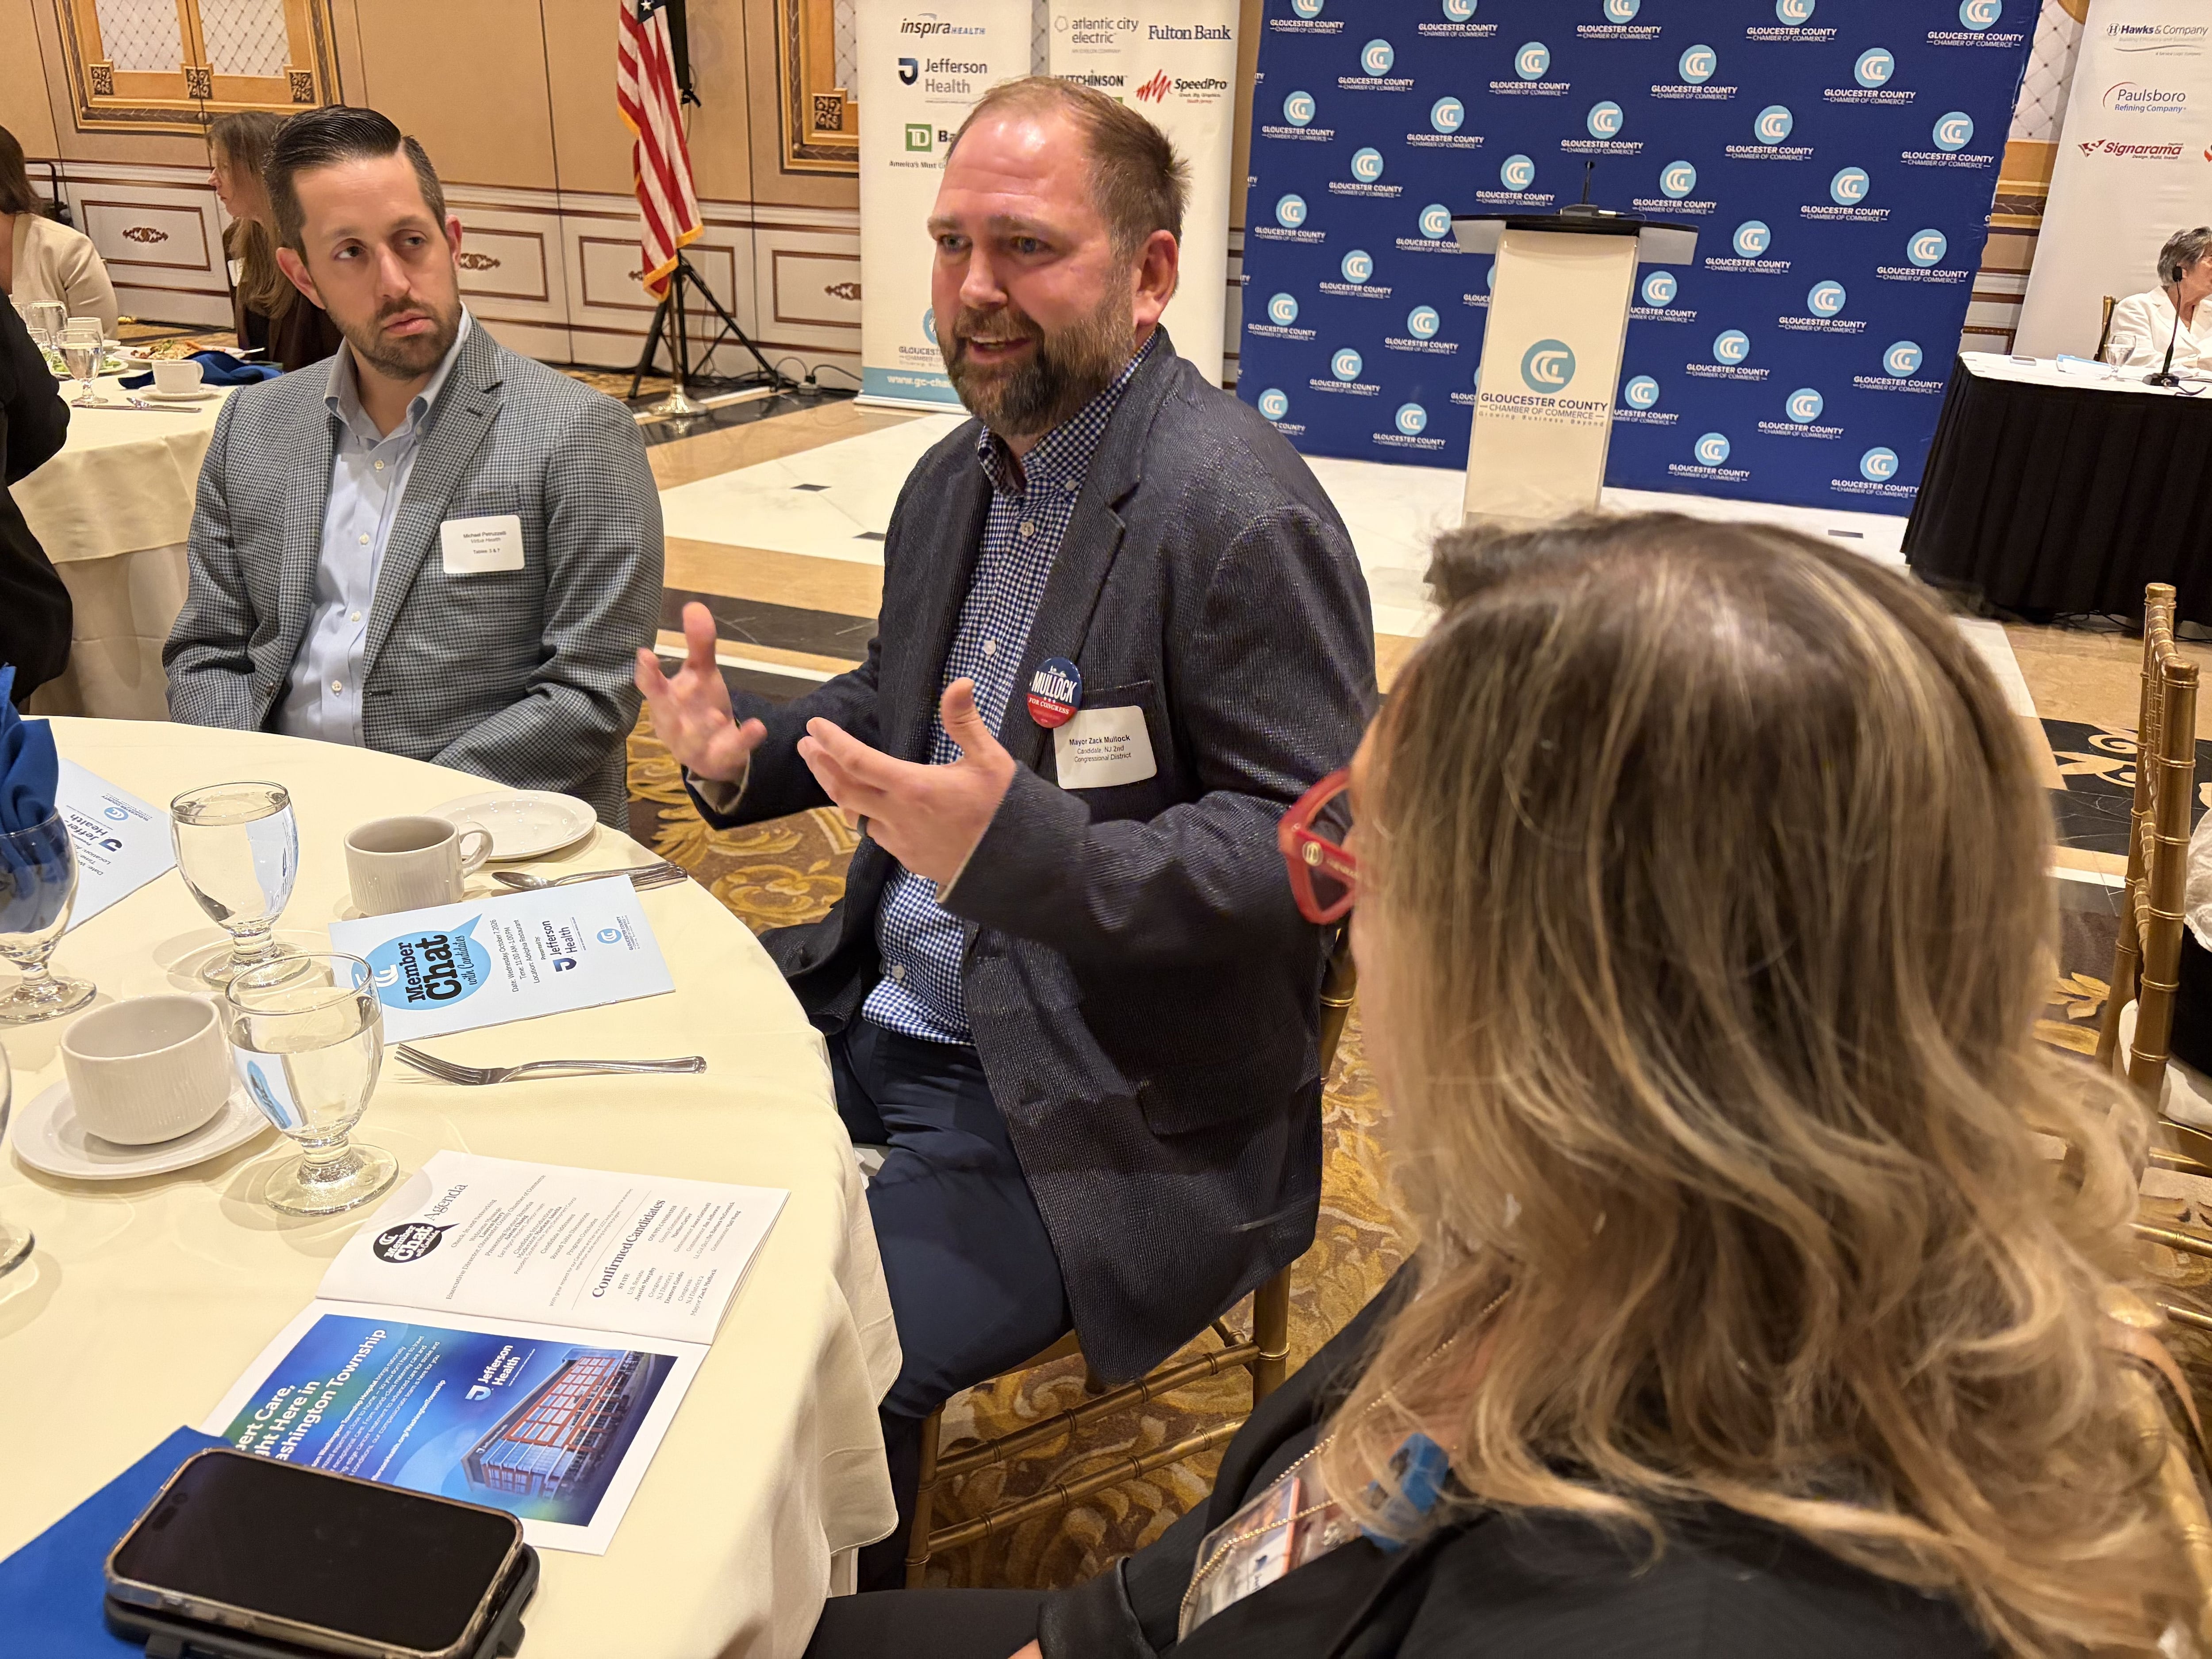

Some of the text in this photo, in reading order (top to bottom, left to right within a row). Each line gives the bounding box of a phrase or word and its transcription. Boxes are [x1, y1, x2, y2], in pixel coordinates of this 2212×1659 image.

[900, 18, 951, 38] inspira
[1072, 17, 1139, 32] atlantic city
[1270, 19, 1314, 27] GLOUCESTER
[1072, 31, 1114, 43] electric
[1148, 25, 1232, 39] Fulton Bank
[1747, 27, 1837, 36] GLOUCESTER COUNTY
[1928, 31, 2024, 42] GLOUCESTER COUNTY
[2121, 25, 2208, 36] Hawks & Company
[925, 58, 987, 73] Jefferson
[925, 79, 970, 93] Health
[1054, 74, 1124, 86] TCHINSON
[1174, 78, 1227, 92] SpeedPro
[1338, 77, 1383, 85] GLOUCESTER
[1651, 85, 1702, 93] GLOUCESTER
[2118, 89, 2186, 102] Paulsboro
[2115, 104, 2182, 113] Refining Company
[907, 128, 931, 146] TD
[1561, 139, 1610, 148] GLOUCESTER
[2104, 142, 2182, 156] Signarama
[1901, 151, 1994, 163] GLOUCESTER COUNTY
[1801, 205, 1891, 216] GLOUCESTER COUNTY
[1877, 266, 1969, 278] GLOUCESTER COUNTY
[1778, 316, 1867, 328] GLOUCESTER COUNTY
[899, 346, 943, 356] GLOUCEST
[887, 376, 953, 388] www.gc-cha
[1854, 376, 1943, 389] GLOUCESTER COUNTY
[1481, 393, 1609, 411] GLOUCESTER COUNTY
[1489, 403, 1529, 414] CHAMBER
[1545, 408, 1593, 420] COMMERCE
[1758, 421, 1844, 434] GLOUCESTER COUNTY
[1373, 433, 1446, 446] GLOUCESTER COUNTY
[1031, 671, 1077, 703] MULLOCK
[1029, 697, 1069, 715] FOR CONGRESS
[1104, 734, 1130, 743] Mullock
[70, 814, 108, 836] Health
[88, 866, 104, 876] Date:
[489, 919, 499, 931] 2026
[513, 919, 526, 942] Restaurant
[542, 920, 562, 956] Jefferson
[558, 926, 578, 954] Health
[616, 916, 634, 950] GLOUCESTER COUNTY
[496, 934, 506, 952] October
[452, 935, 478, 985] with Candidates
[512, 953, 522, 966] 11:00
[398, 942, 426, 1003] Member
[415, 934, 462, 1000] Chat
[518, 966, 527, 980] Time:
[529, 962, 540, 984] Location:
[511, 979, 519, 992] Date:
[423, 1185, 468, 1221] Agenda
[383, 1225, 416, 1258] Member
[391, 1226, 434, 1261] Chat
[592, 1200, 665, 1298] Confirmed Candidates
[445, 1270, 466, 1300] Executive
[477, 1345, 513, 1384] Jefferson
[491, 1356, 521, 1386] Health
[275, 1330, 387, 1461] ashington Township
[235, 1385, 296, 1451] ert Care,
[253, 1381, 320, 1456] ght Here in
[318, 1424, 345, 1455] Washington
[340, 1400, 363, 1424] Township
[359, 1380, 379, 1400] Hospital
[371, 1380, 446, 1481] ffersonHealth.org/WashingtonTownship
